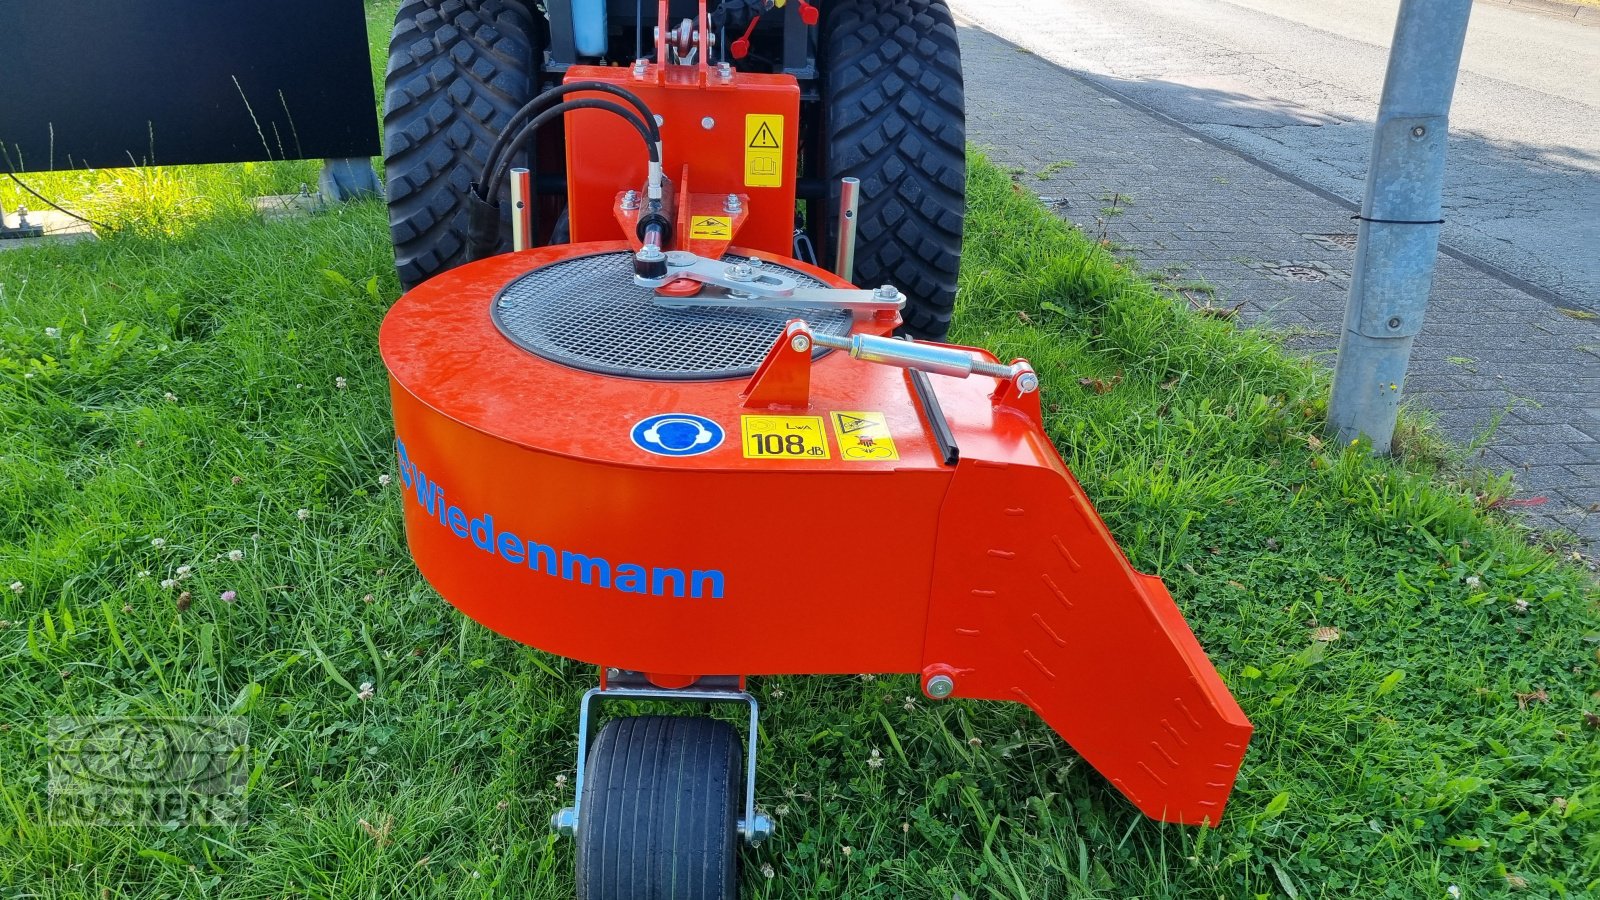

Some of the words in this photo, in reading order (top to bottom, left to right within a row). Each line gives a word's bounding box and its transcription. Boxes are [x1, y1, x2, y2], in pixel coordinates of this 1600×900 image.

[751, 433, 805, 455] 108
[806, 446, 824, 455] dB
[411, 463, 725, 599] Wiedenmann
